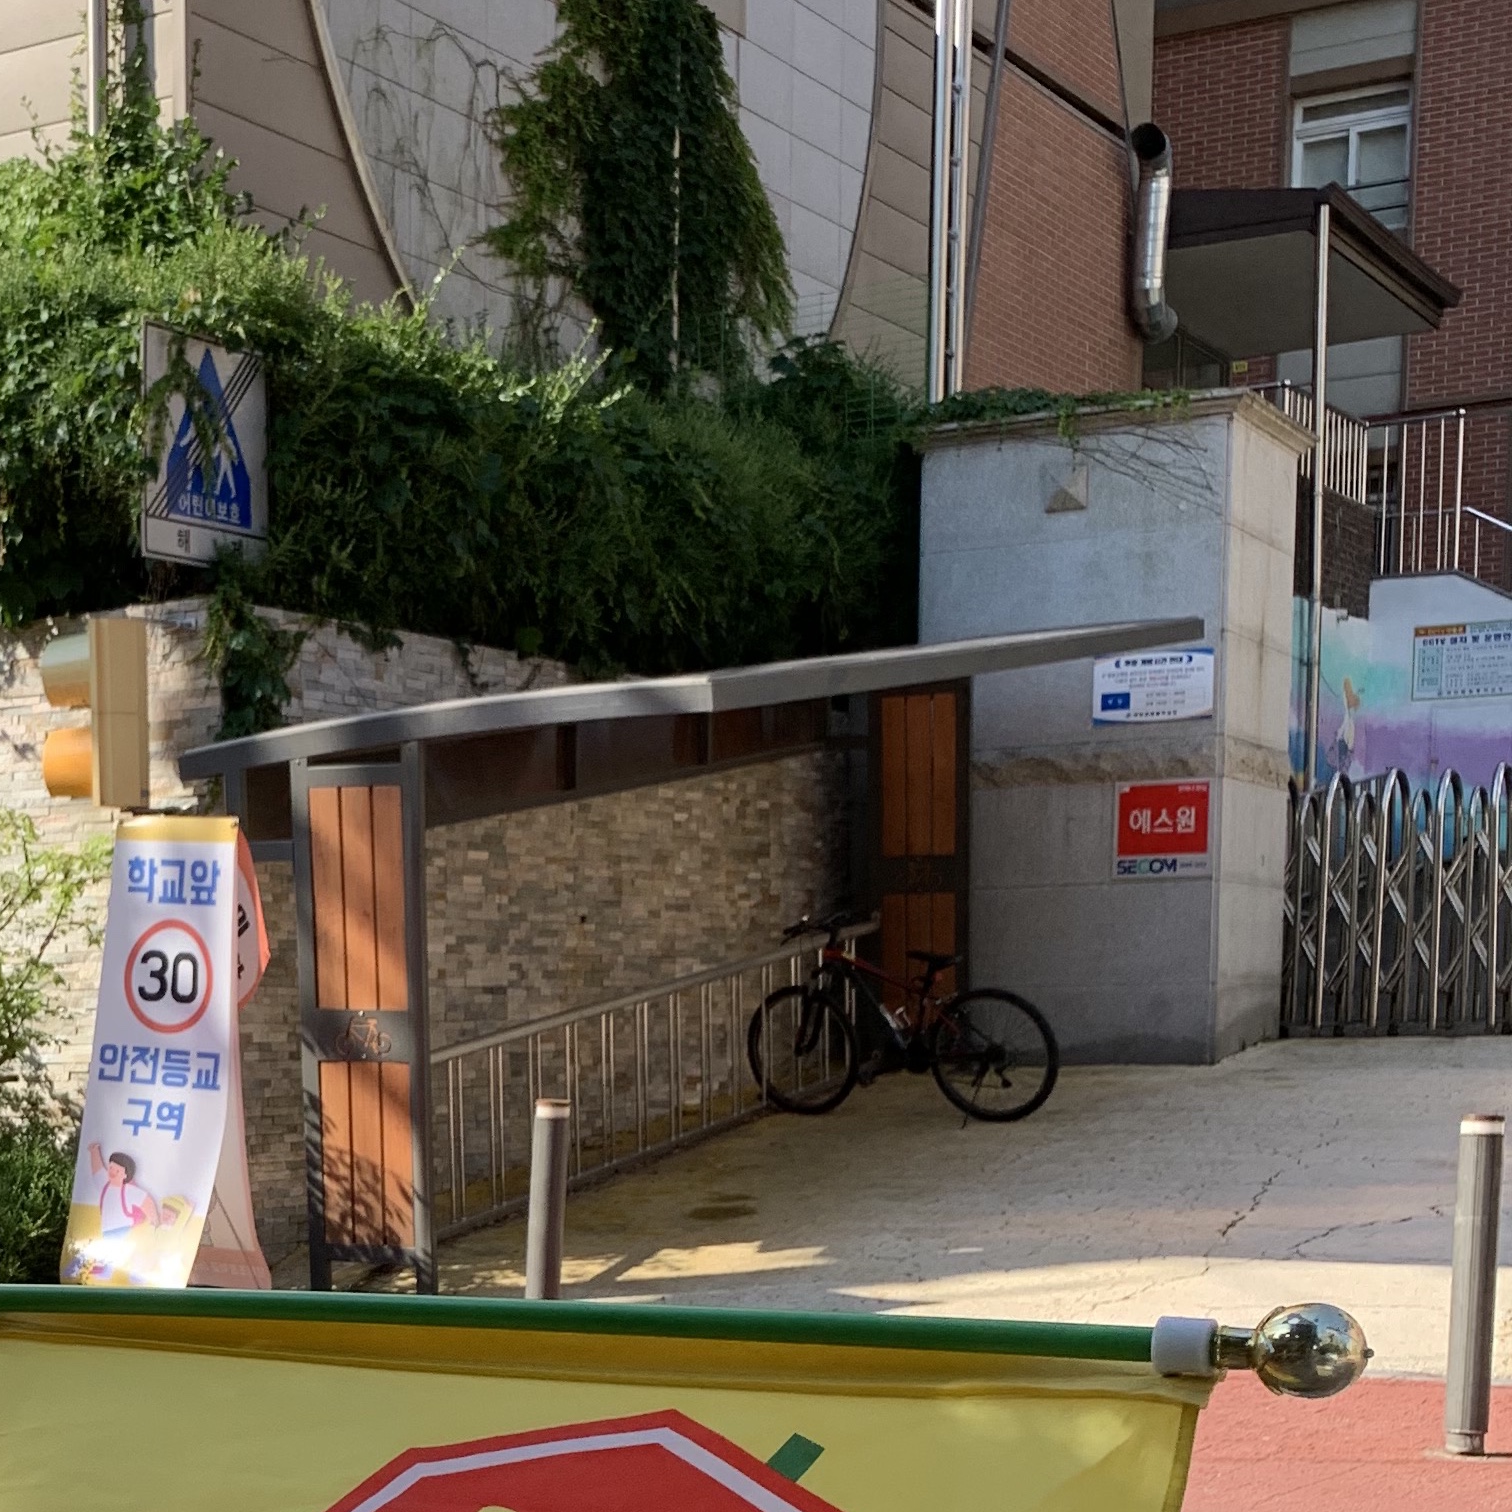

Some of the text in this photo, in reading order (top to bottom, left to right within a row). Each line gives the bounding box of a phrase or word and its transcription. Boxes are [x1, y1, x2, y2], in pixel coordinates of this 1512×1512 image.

[1129, 806, 1197, 834] 에스원
[127, 856, 221, 906] 학교앞
[1117, 858, 1178, 875] SECOM
[137, 949, 199, 1004] 30
[98, 1043, 221, 1091] 안전등교
[122, 1098, 186, 1141] 구역
